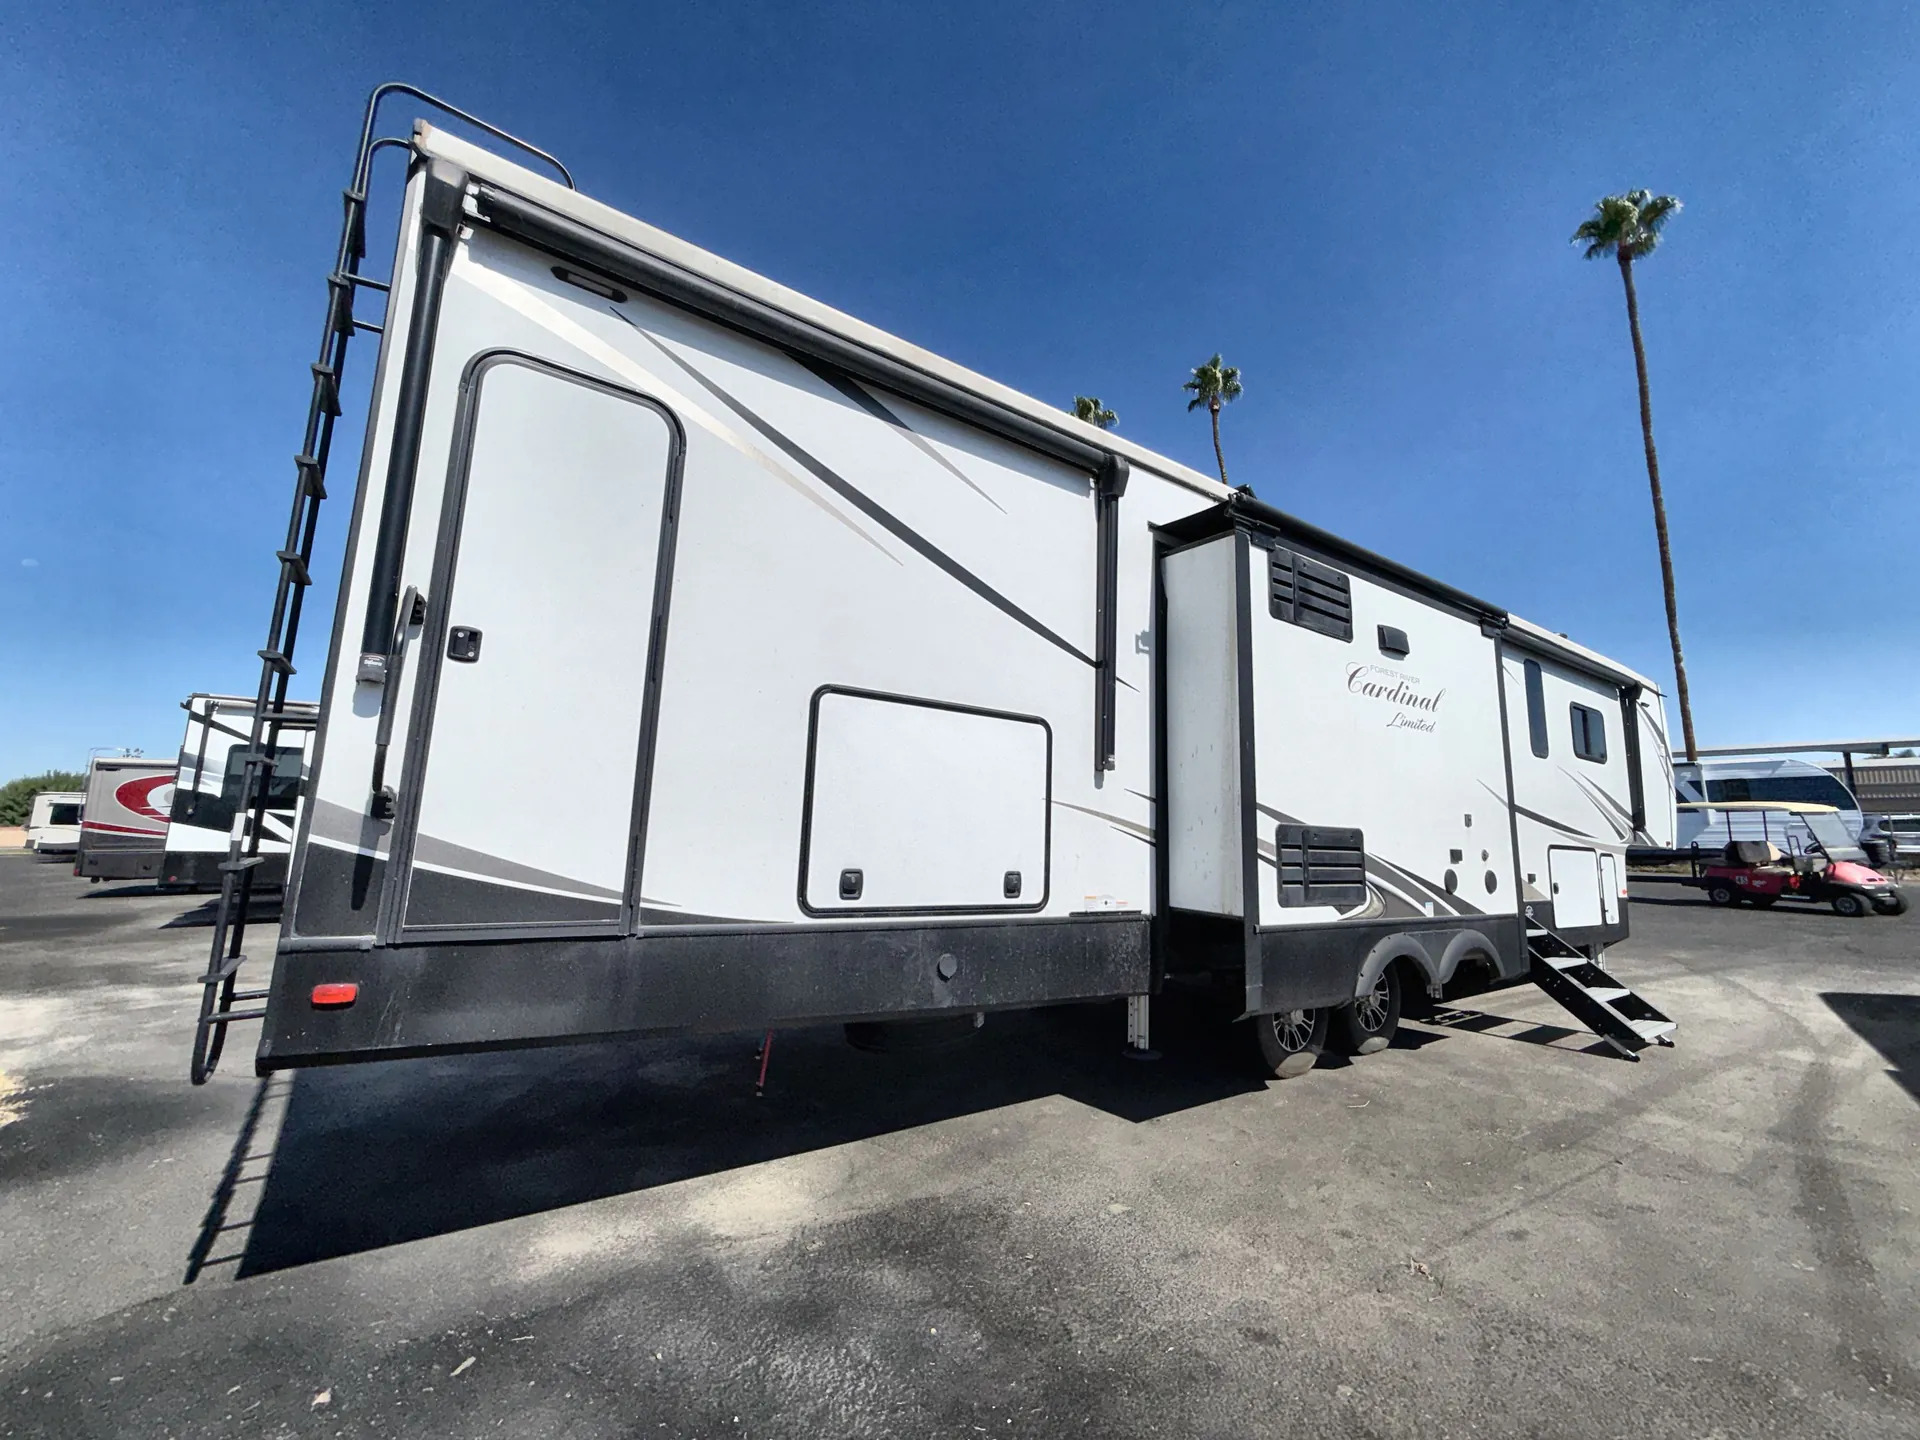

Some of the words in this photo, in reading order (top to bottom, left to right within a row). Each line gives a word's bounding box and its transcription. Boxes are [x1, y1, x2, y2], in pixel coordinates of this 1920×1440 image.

[1370, 665, 1398, 679] FOREST
[1400, 673, 1420, 684] RIVER
[1345, 661, 1447, 712] Cardinal
[1386, 711, 1436, 733] Limited
